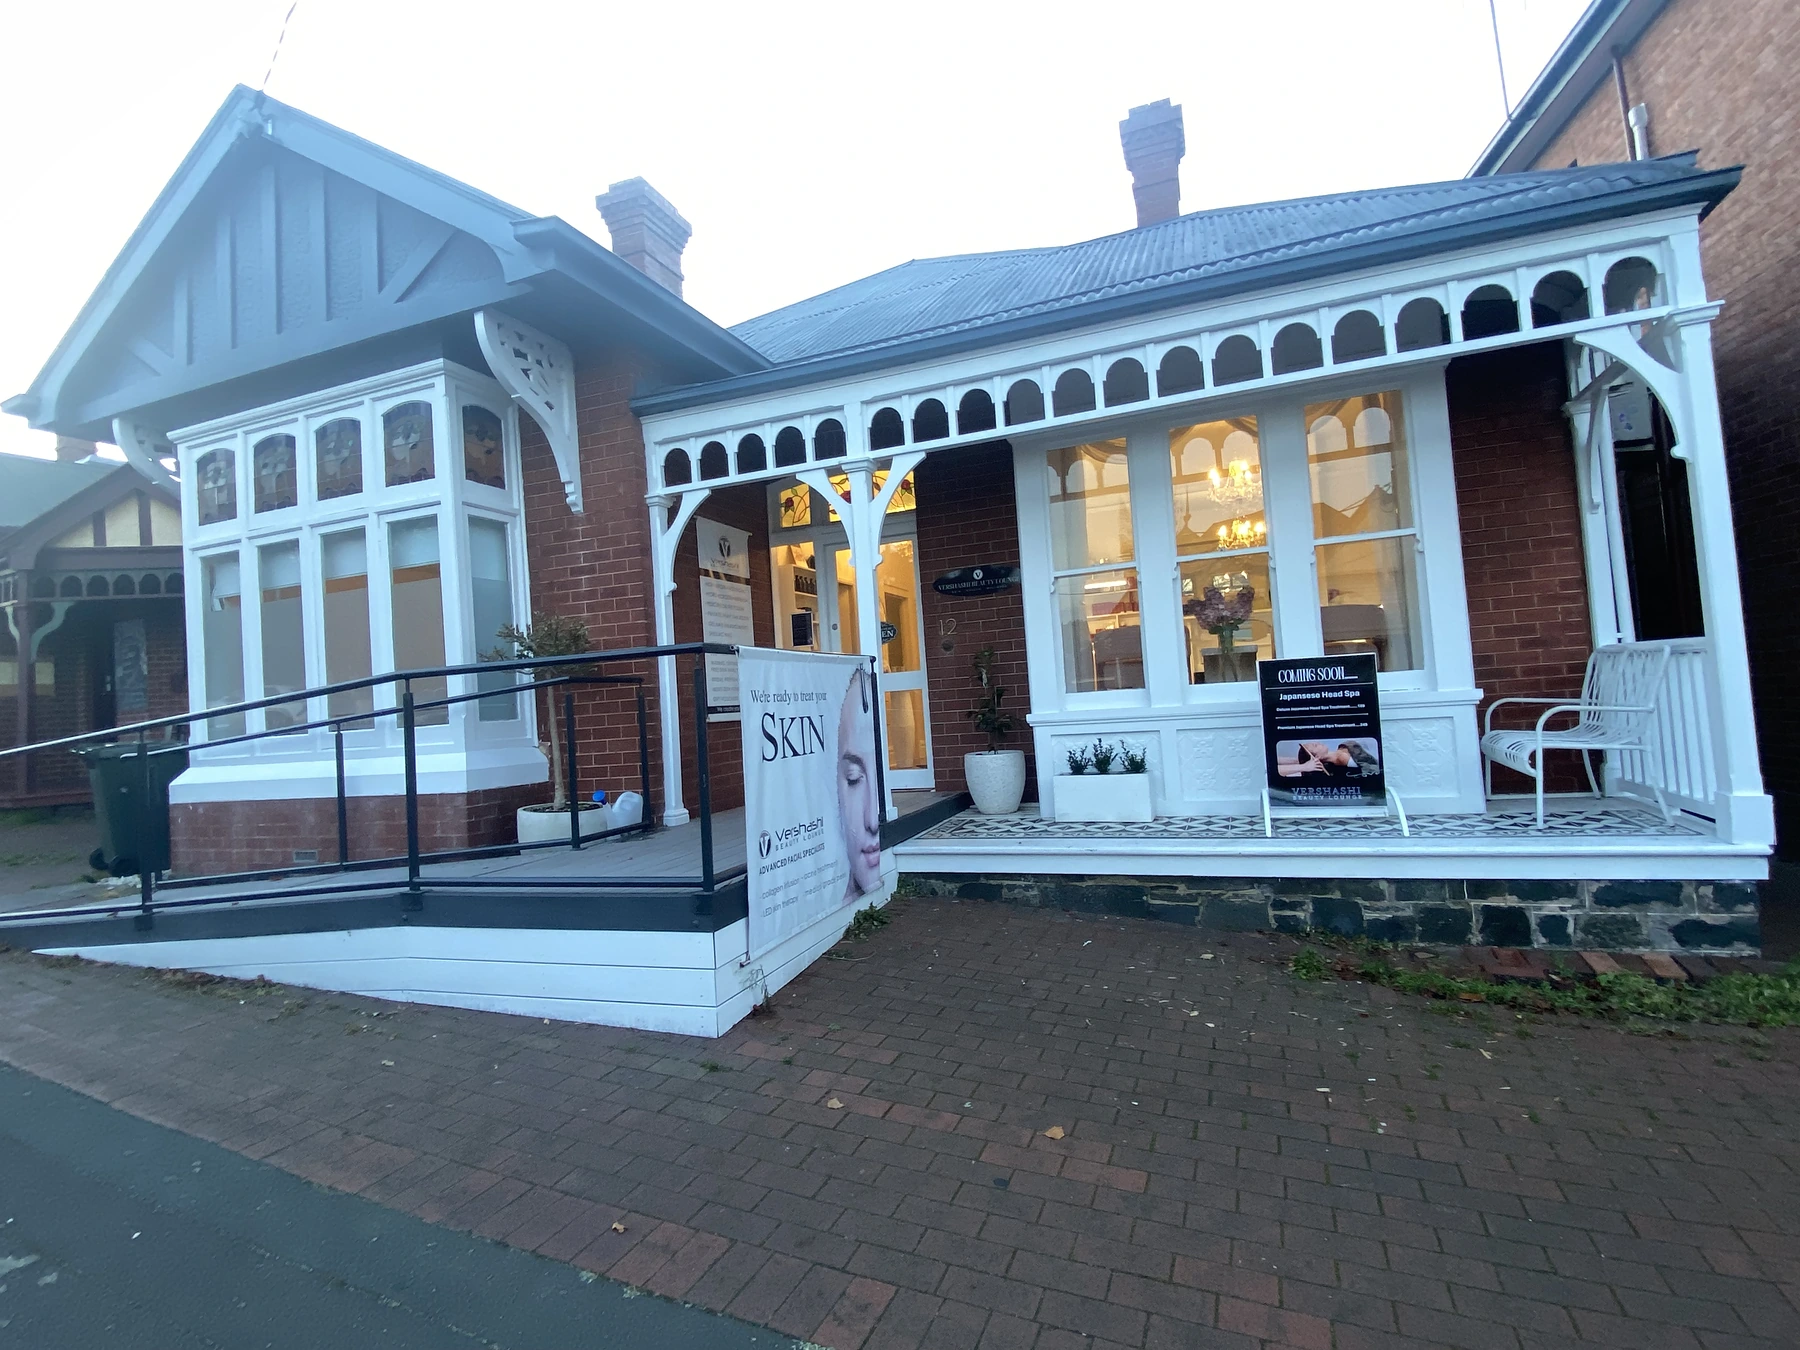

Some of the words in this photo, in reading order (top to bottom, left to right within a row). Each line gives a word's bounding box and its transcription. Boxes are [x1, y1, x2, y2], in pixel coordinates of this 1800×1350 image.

[940, 618, 957, 635] 12
[1278, 668, 1316, 683] COMING
[750, 690, 771, 703] We're
[773, 690, 791, 705] ready
[793, 692, 799, 701] to
[800, 691, 814, 702] treat
[815, 692, 827, 704] your
[1321, 690, 1343, 698] Head
[1344, 690, 1360, 698] Spa
[761, 712, 825, 762] SKIN
[1291, 787, 1362, 796] VERSHASHI
[759, 857, 788, 876] ADVANCED
[787, 851, 803, 865] FACIAL
